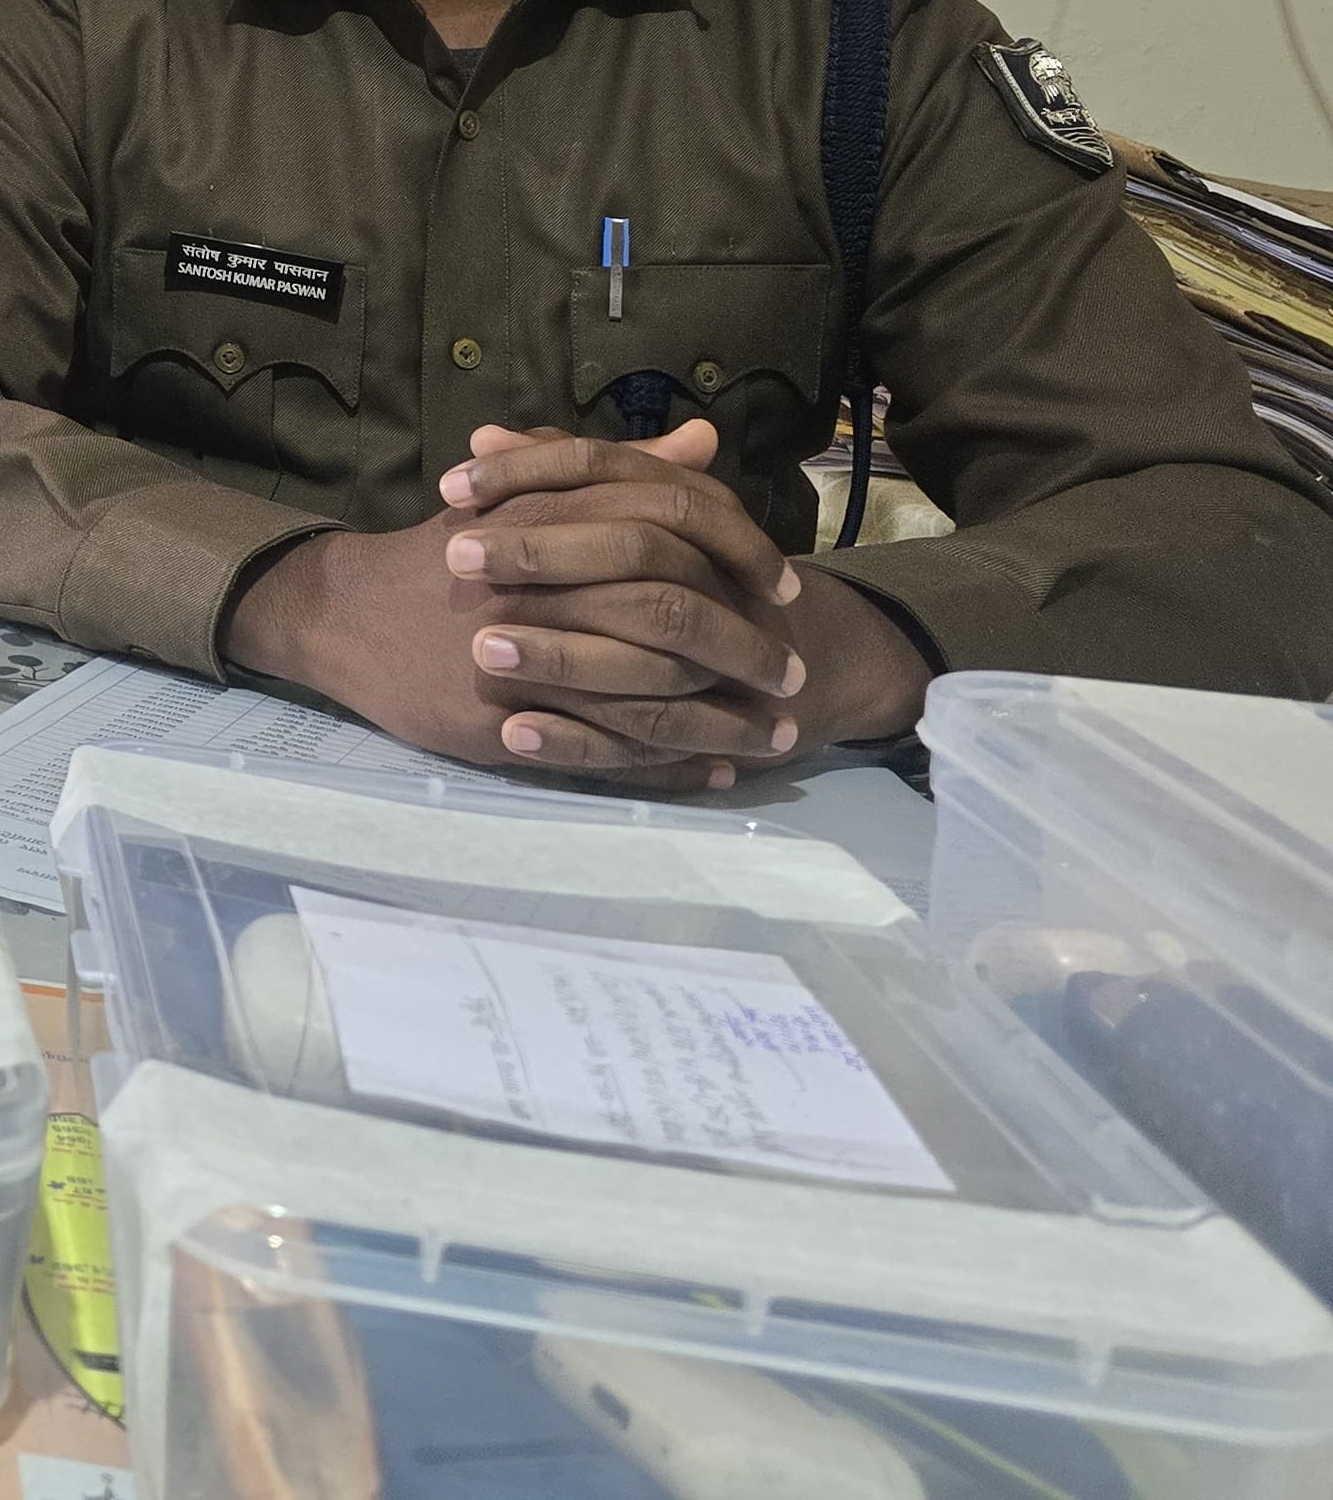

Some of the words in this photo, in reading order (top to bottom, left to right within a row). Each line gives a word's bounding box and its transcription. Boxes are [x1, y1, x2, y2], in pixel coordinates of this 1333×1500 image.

[177, 261, 232, 284] SANTOSH
[232, 272, 277, 291] KUMAR
[276, 280, 327, 301] PASWAN
[181, 243, 222, 263] संतोष
[226, 252, 268, 270] कुमार
[272, 260, 330, 283] पासवान
